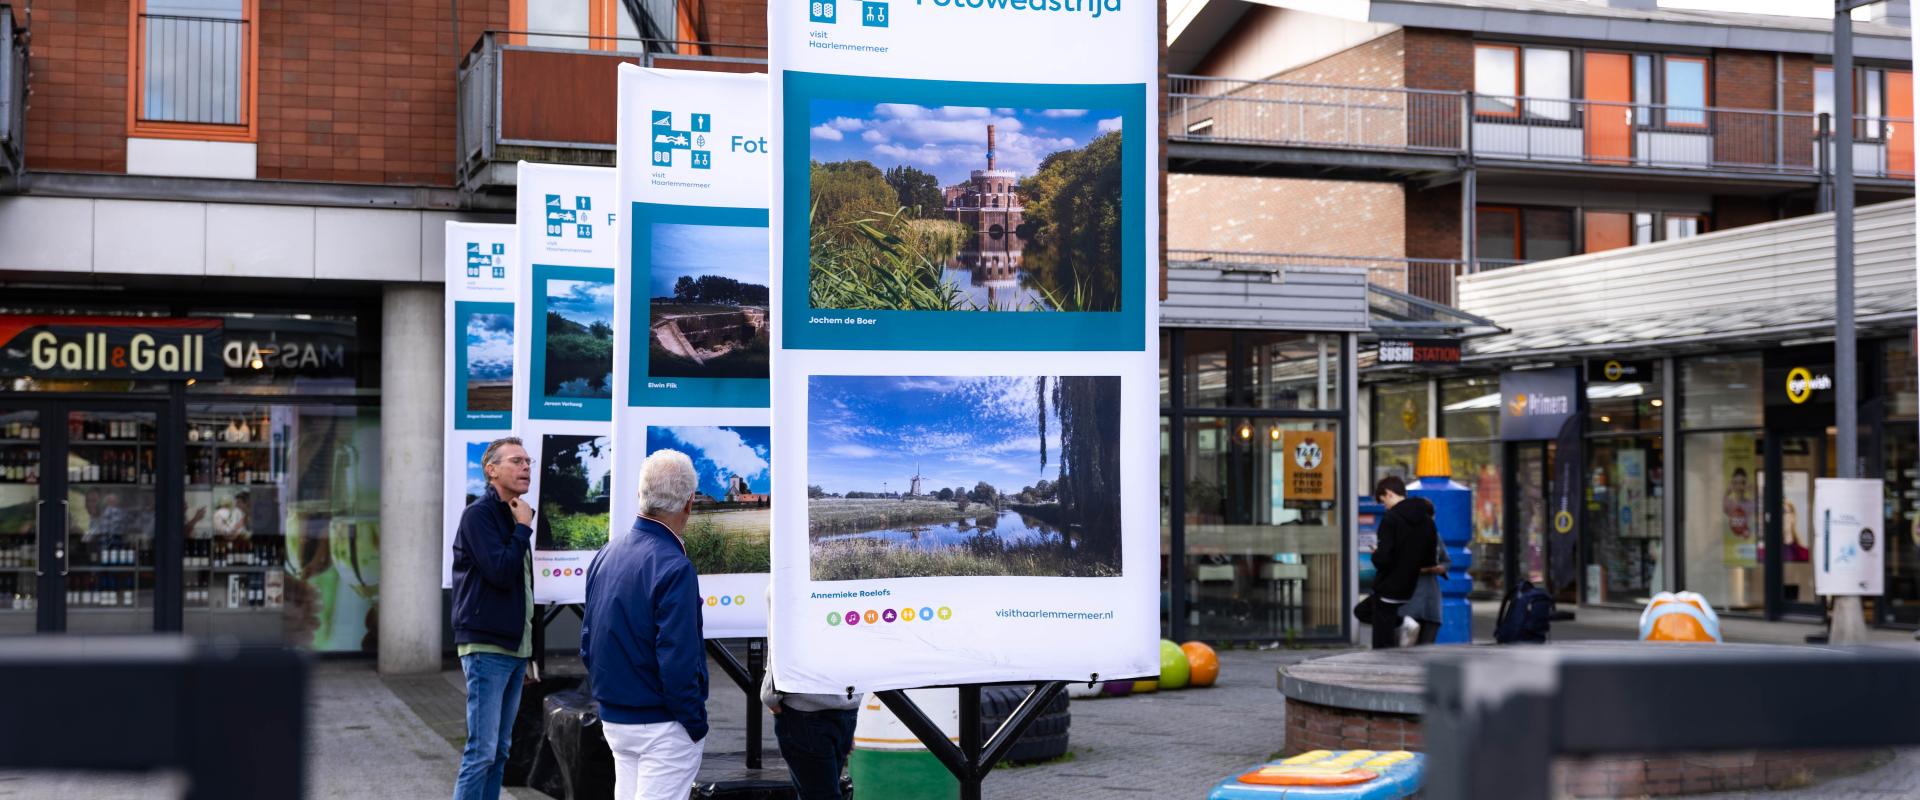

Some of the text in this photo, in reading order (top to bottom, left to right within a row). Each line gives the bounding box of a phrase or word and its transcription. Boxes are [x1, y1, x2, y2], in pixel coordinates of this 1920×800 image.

[809, 30, 828, 39] visit
[808, 40, 889, 53] Haarlemmermeer
[808, 316, 843, 324] Jochem
[856, 317, 877, 325] Boer
[31, 331, 204, 372] Gall & Gall
[1380, 346, 1459, 362] SUSHI STATION
[1528, 393, 1568, 416] Primera
[810, 588, 891, 599] Annemieke Roelofs
[995, 608, 1114, 620] visithaarlemmermeer.nl
